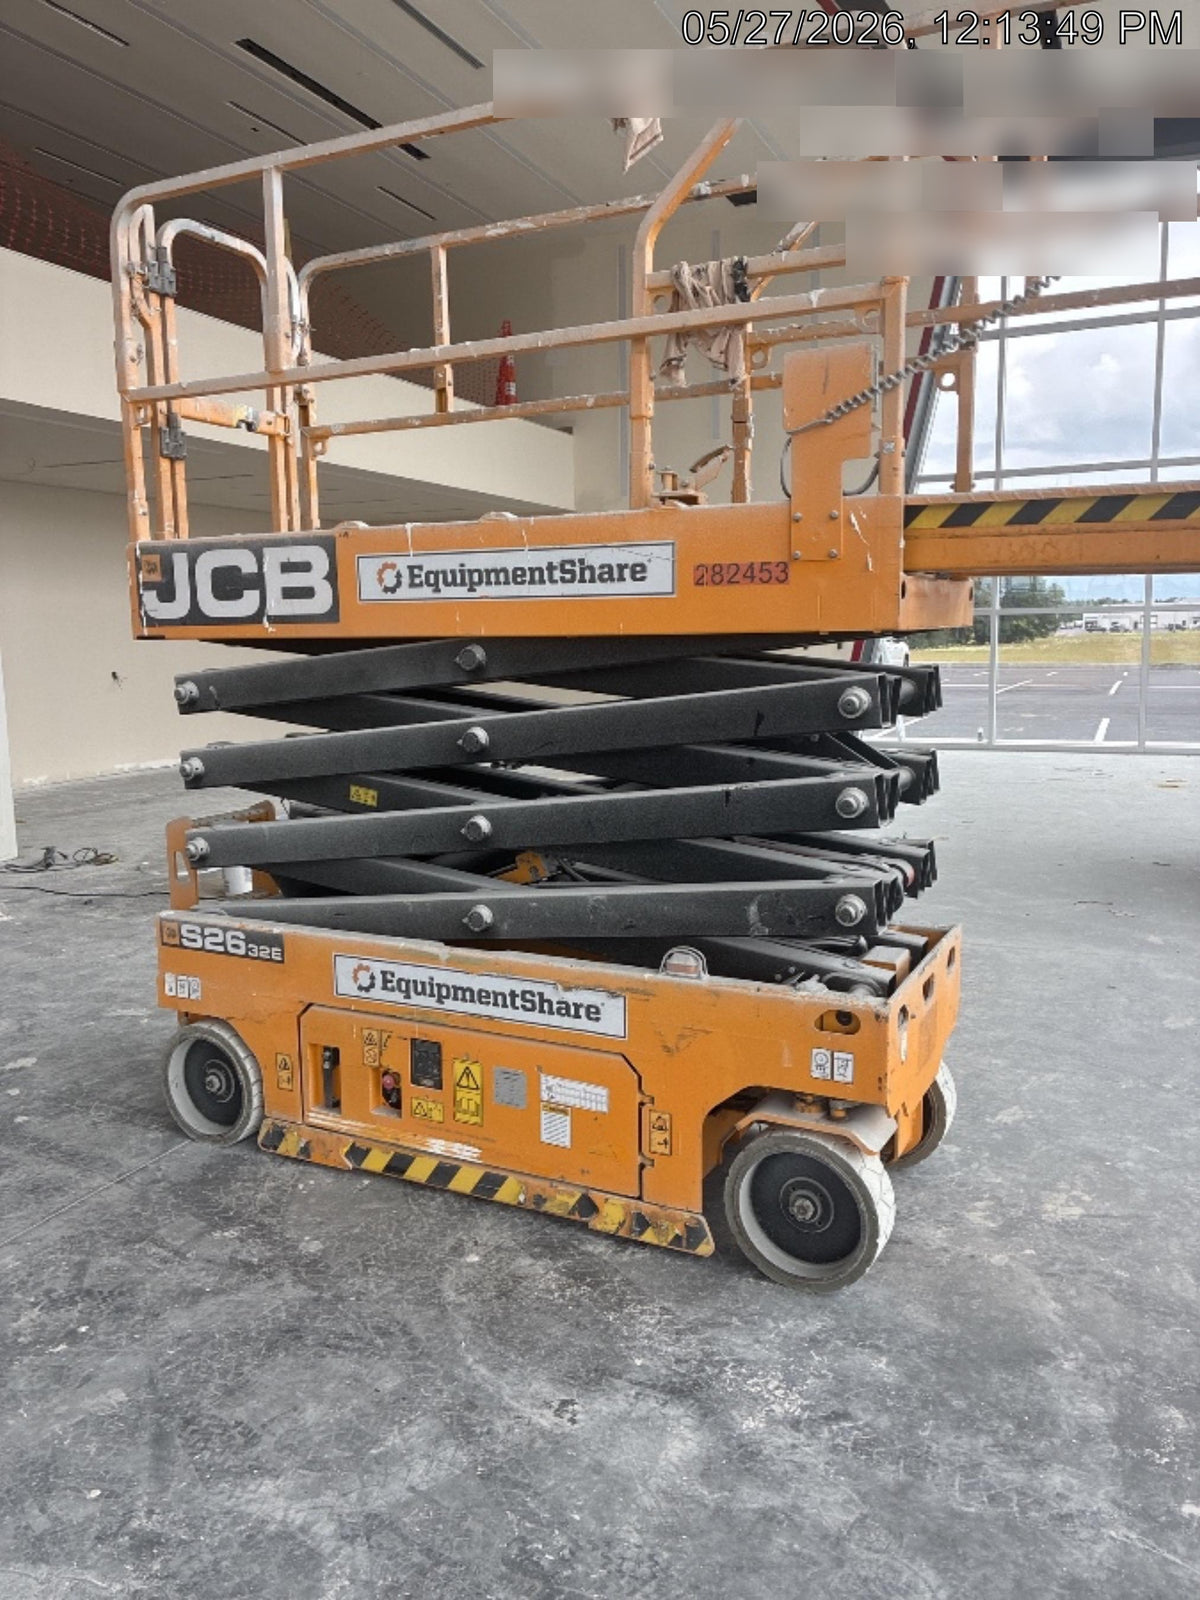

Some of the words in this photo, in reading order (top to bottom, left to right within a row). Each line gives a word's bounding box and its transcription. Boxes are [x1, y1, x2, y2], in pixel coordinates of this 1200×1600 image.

[141, 545, 333, 619] JCB
[408, 557, 647, 593] EquipmentShare
[695, 561, 789, 586] 282453
[180, 924, 246, 955] S26
[247, 943, 283, 960] 32E
[380, 969, 601, 1022] EquipmentShare
